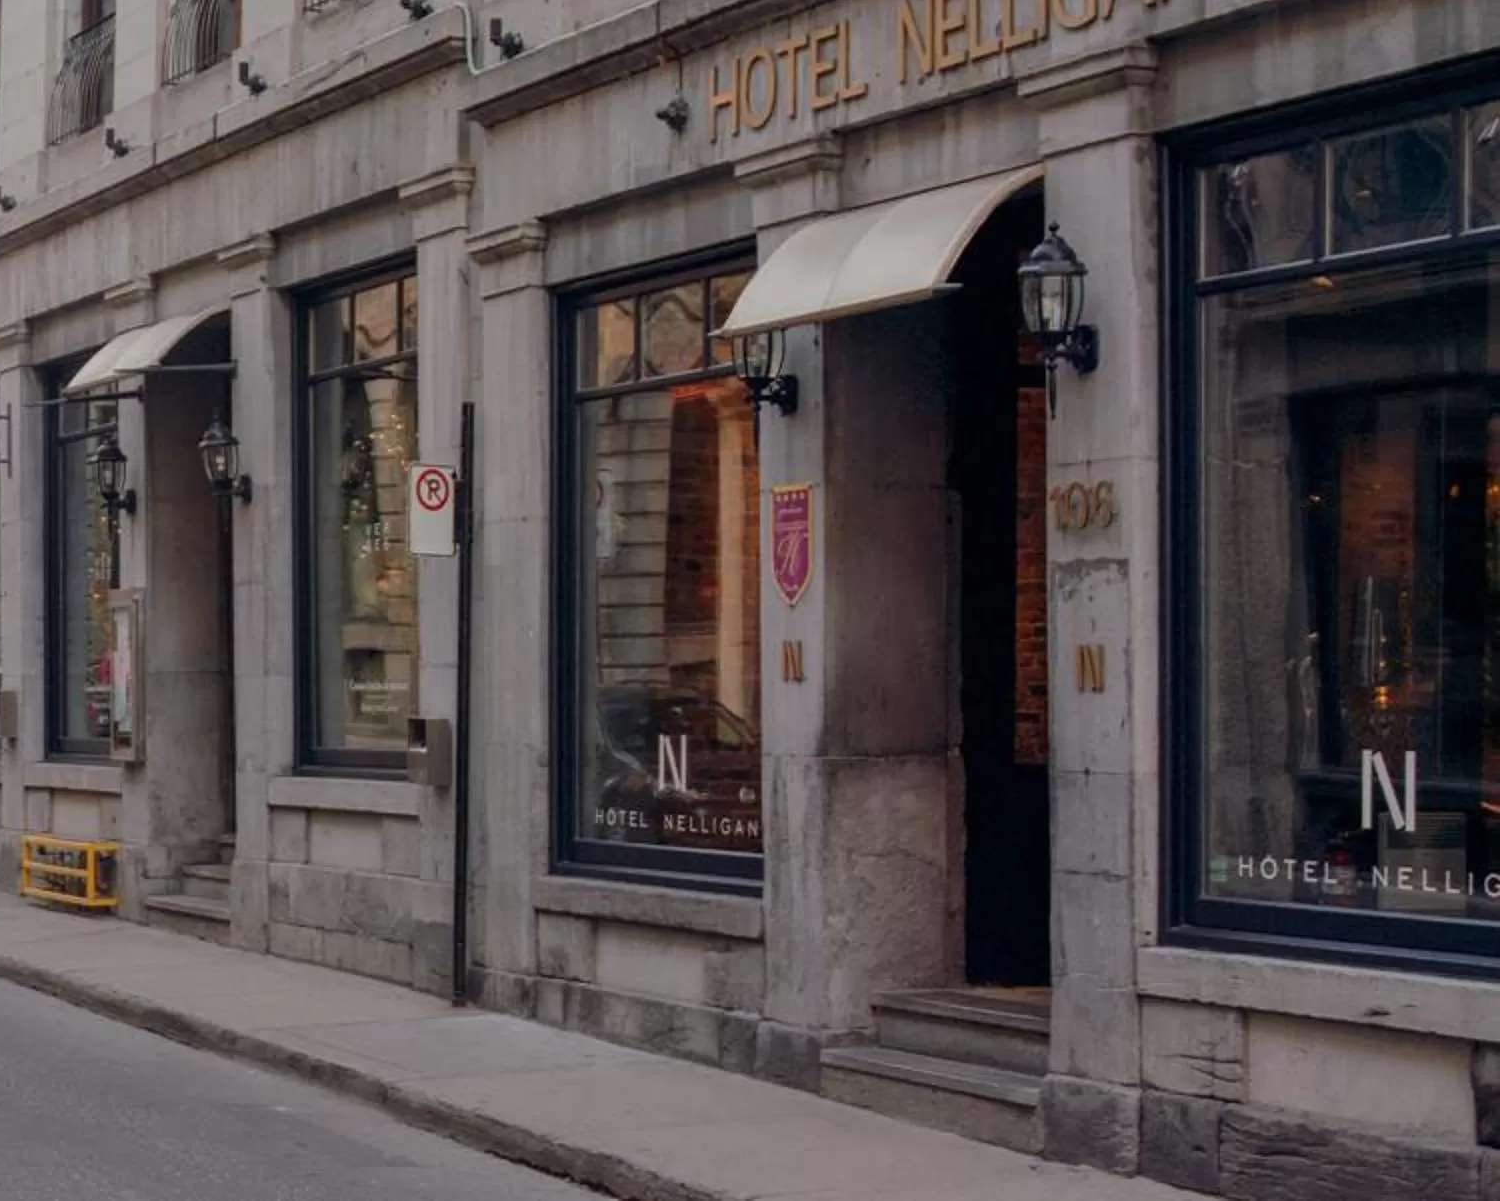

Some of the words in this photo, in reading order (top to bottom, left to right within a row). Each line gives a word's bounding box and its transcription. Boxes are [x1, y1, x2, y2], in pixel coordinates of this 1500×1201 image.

[706, 18, 869, 143] HOTEL
[1050, 482, 1118, 531] 106
[659, 734, 687, 792] N
[1361, 749, 1416, 832] N
[663, 814, 760, 836] NELLIGAN
